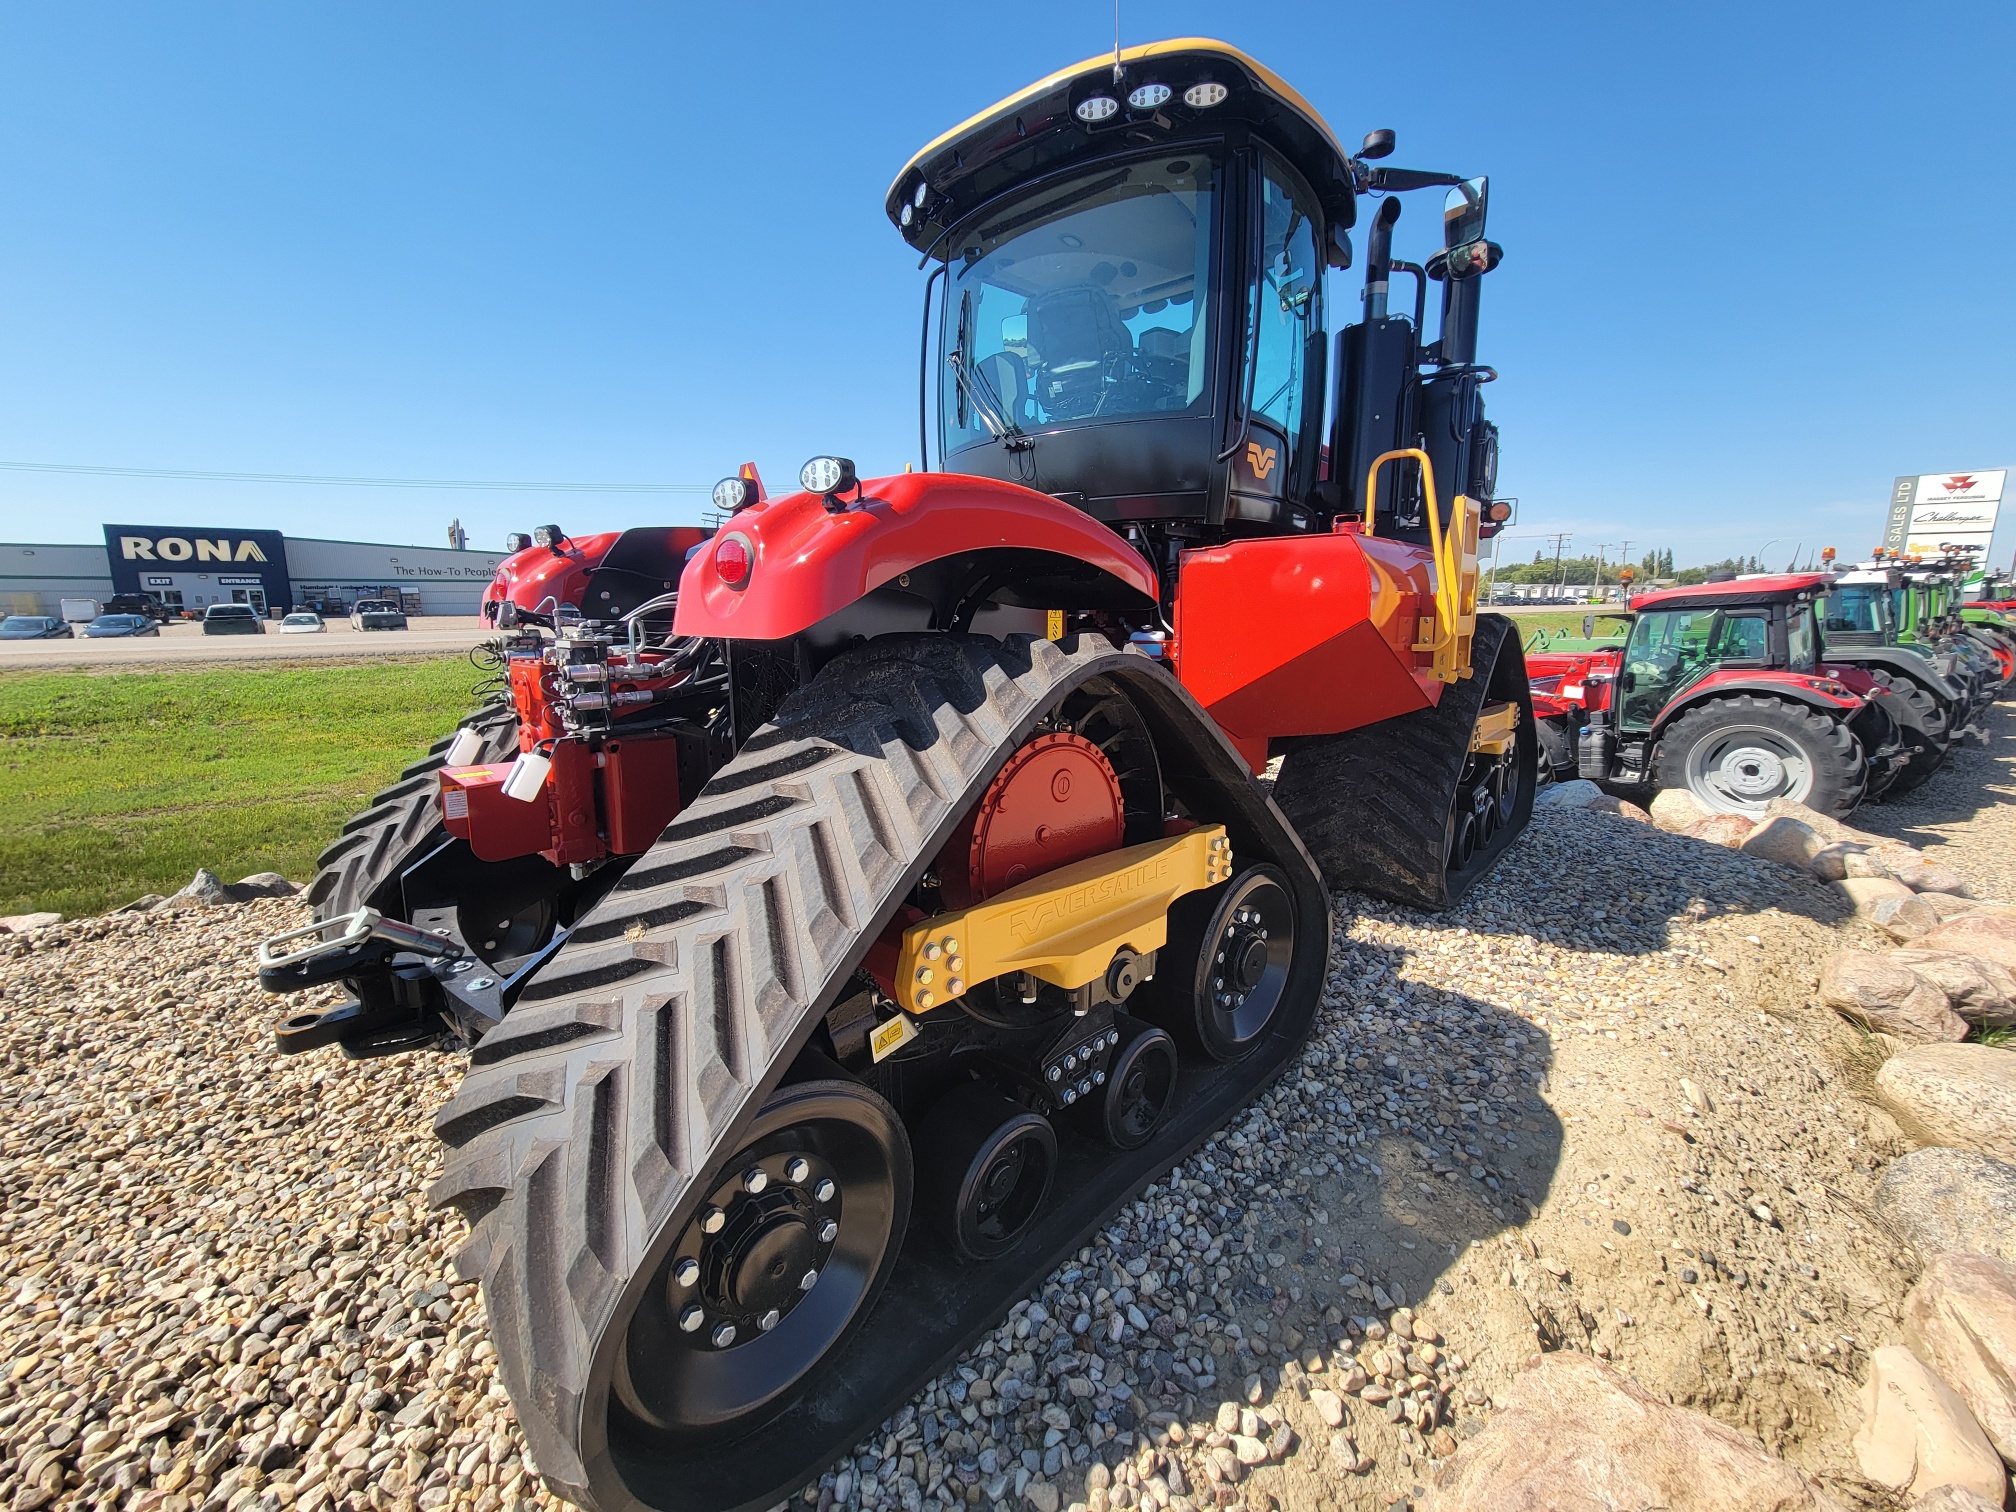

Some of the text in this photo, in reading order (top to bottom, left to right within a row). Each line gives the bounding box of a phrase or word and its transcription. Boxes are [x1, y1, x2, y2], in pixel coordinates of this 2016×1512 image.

[1896, 482, 1912, 503] LTD
[1889, 506, 1907, 542] SALES
[1913, 511, 1984, 525] Challenger
[120, 536, 268, 562] RONA
[394, 566, 497, 578] The How-To People
[1054, 857, 1168, 918] VERSATILE
